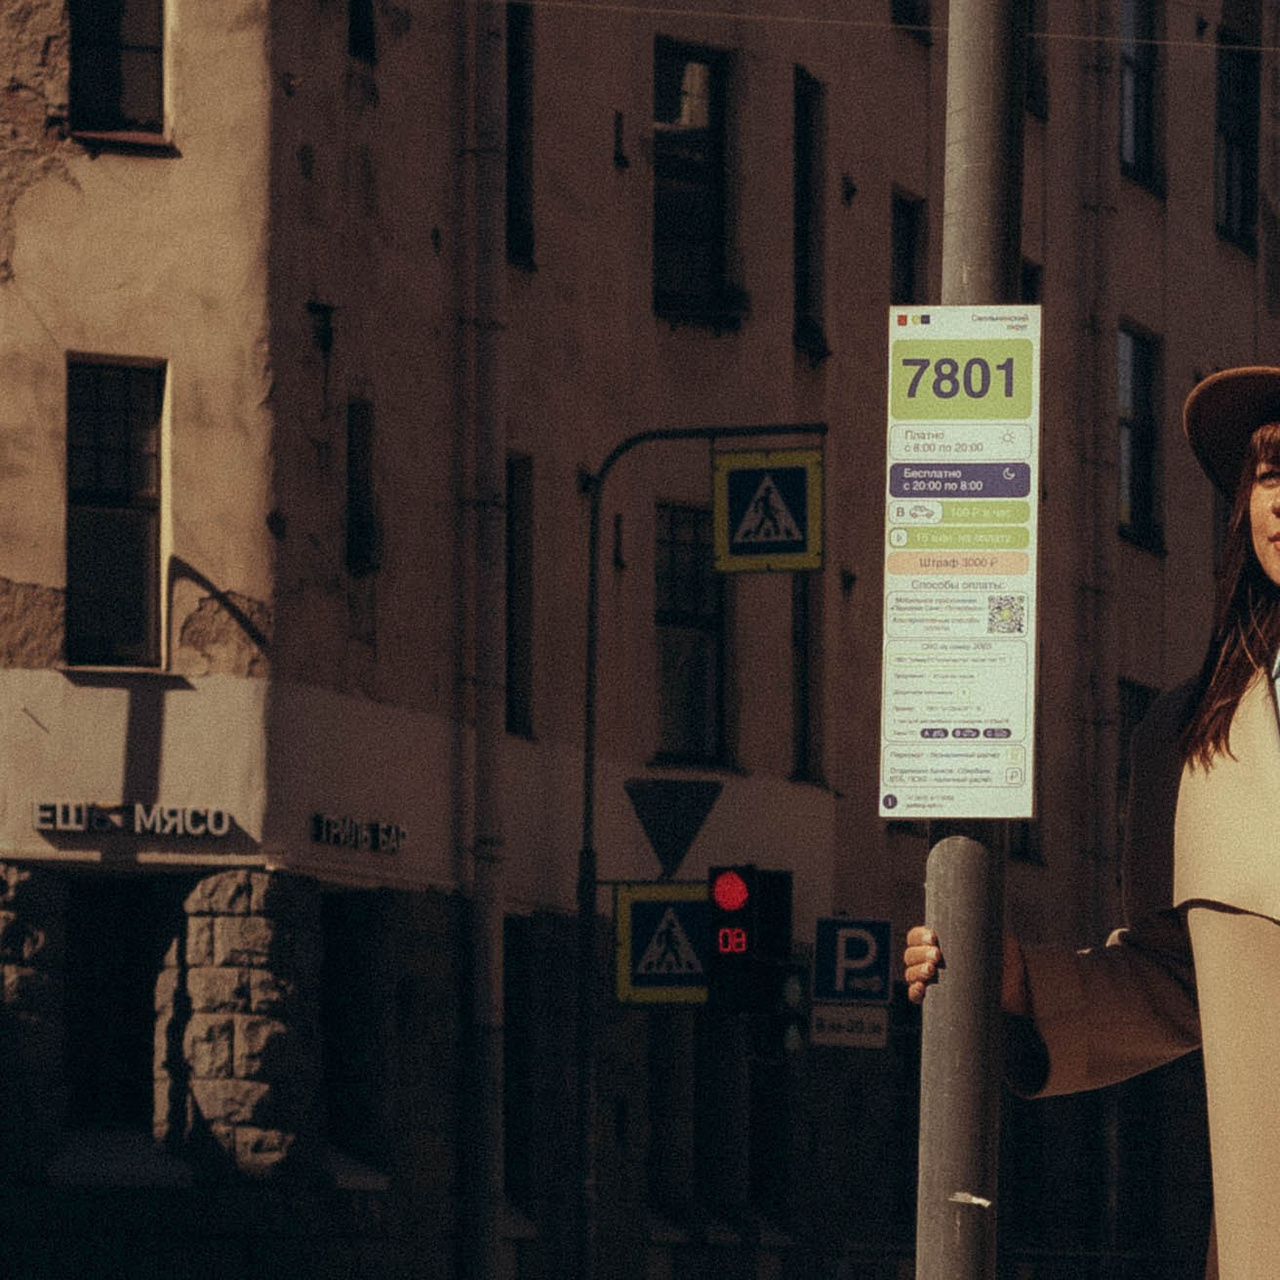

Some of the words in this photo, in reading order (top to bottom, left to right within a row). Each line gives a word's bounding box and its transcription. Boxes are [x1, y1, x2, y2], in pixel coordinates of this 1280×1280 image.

[902, 357, 1015, 399] 7801
[905, 430, 945, 440] Платно
[954, 443, 984, 453] 20:00
[903, 468, 962, 478] Бесплатно
[912, 481, 942, 491] 20:00
[944, 483, 958, 491] по
[959, 481, 984, 491] 8:00
[919, 558, 959, 569] Штраф
[961, 557, 988, 568] 3000
[911, 579, 959, 590] Способы
[133, 803, 231, 837] МЯСО
